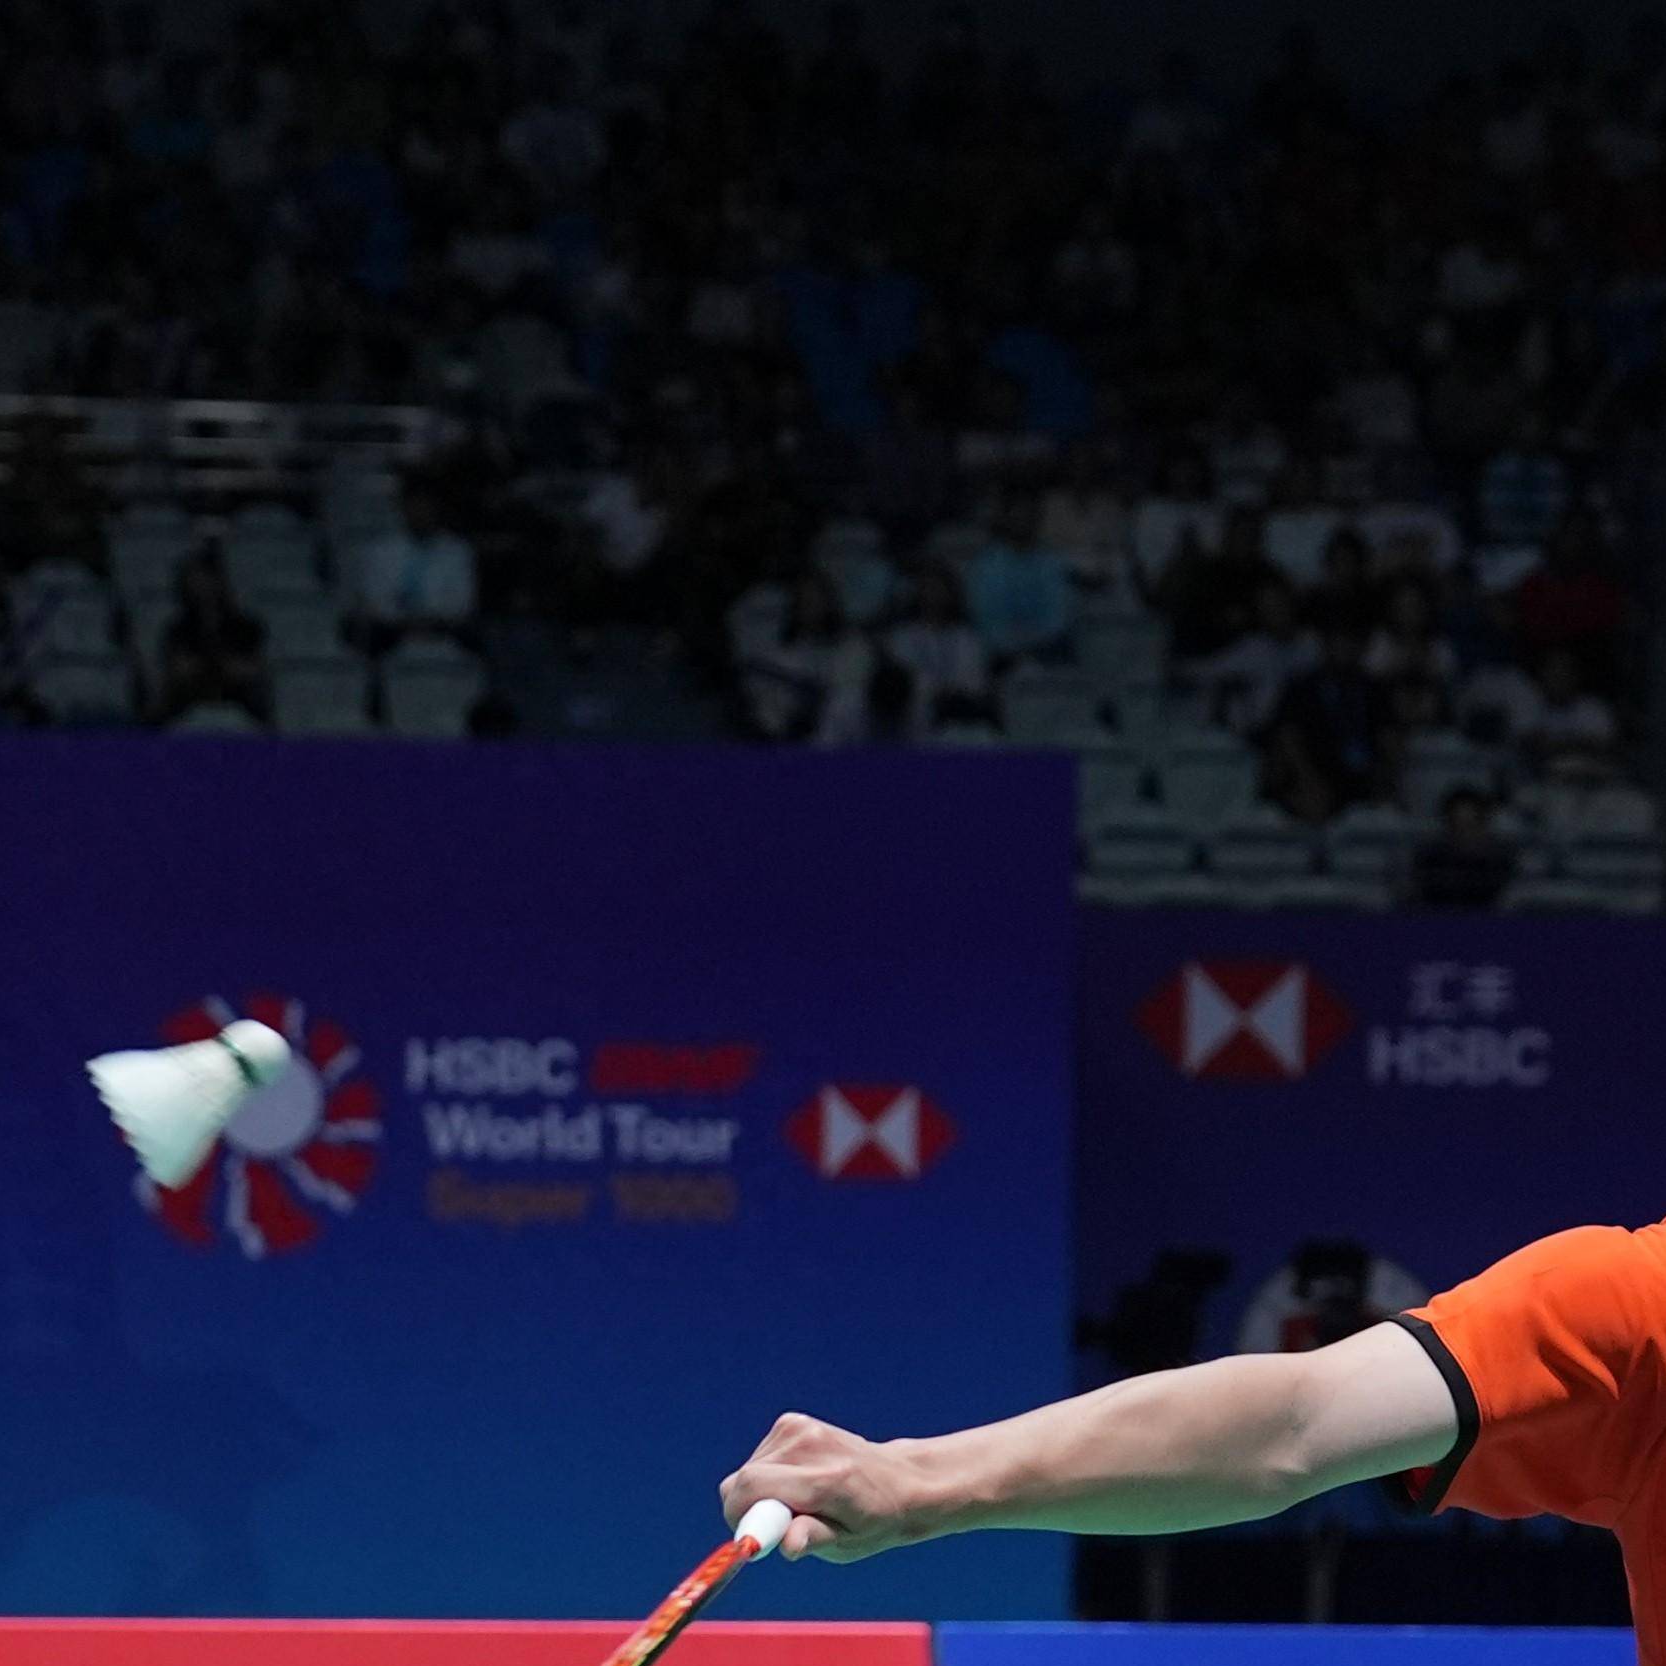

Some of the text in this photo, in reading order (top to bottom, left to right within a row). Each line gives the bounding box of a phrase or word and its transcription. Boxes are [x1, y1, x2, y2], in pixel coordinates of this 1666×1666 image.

[404, 1037, 579, 1096] HSBC
[1368, 1025, 1552, 1086] HSBC
[425, 1103, 739, 1163] World Tour
